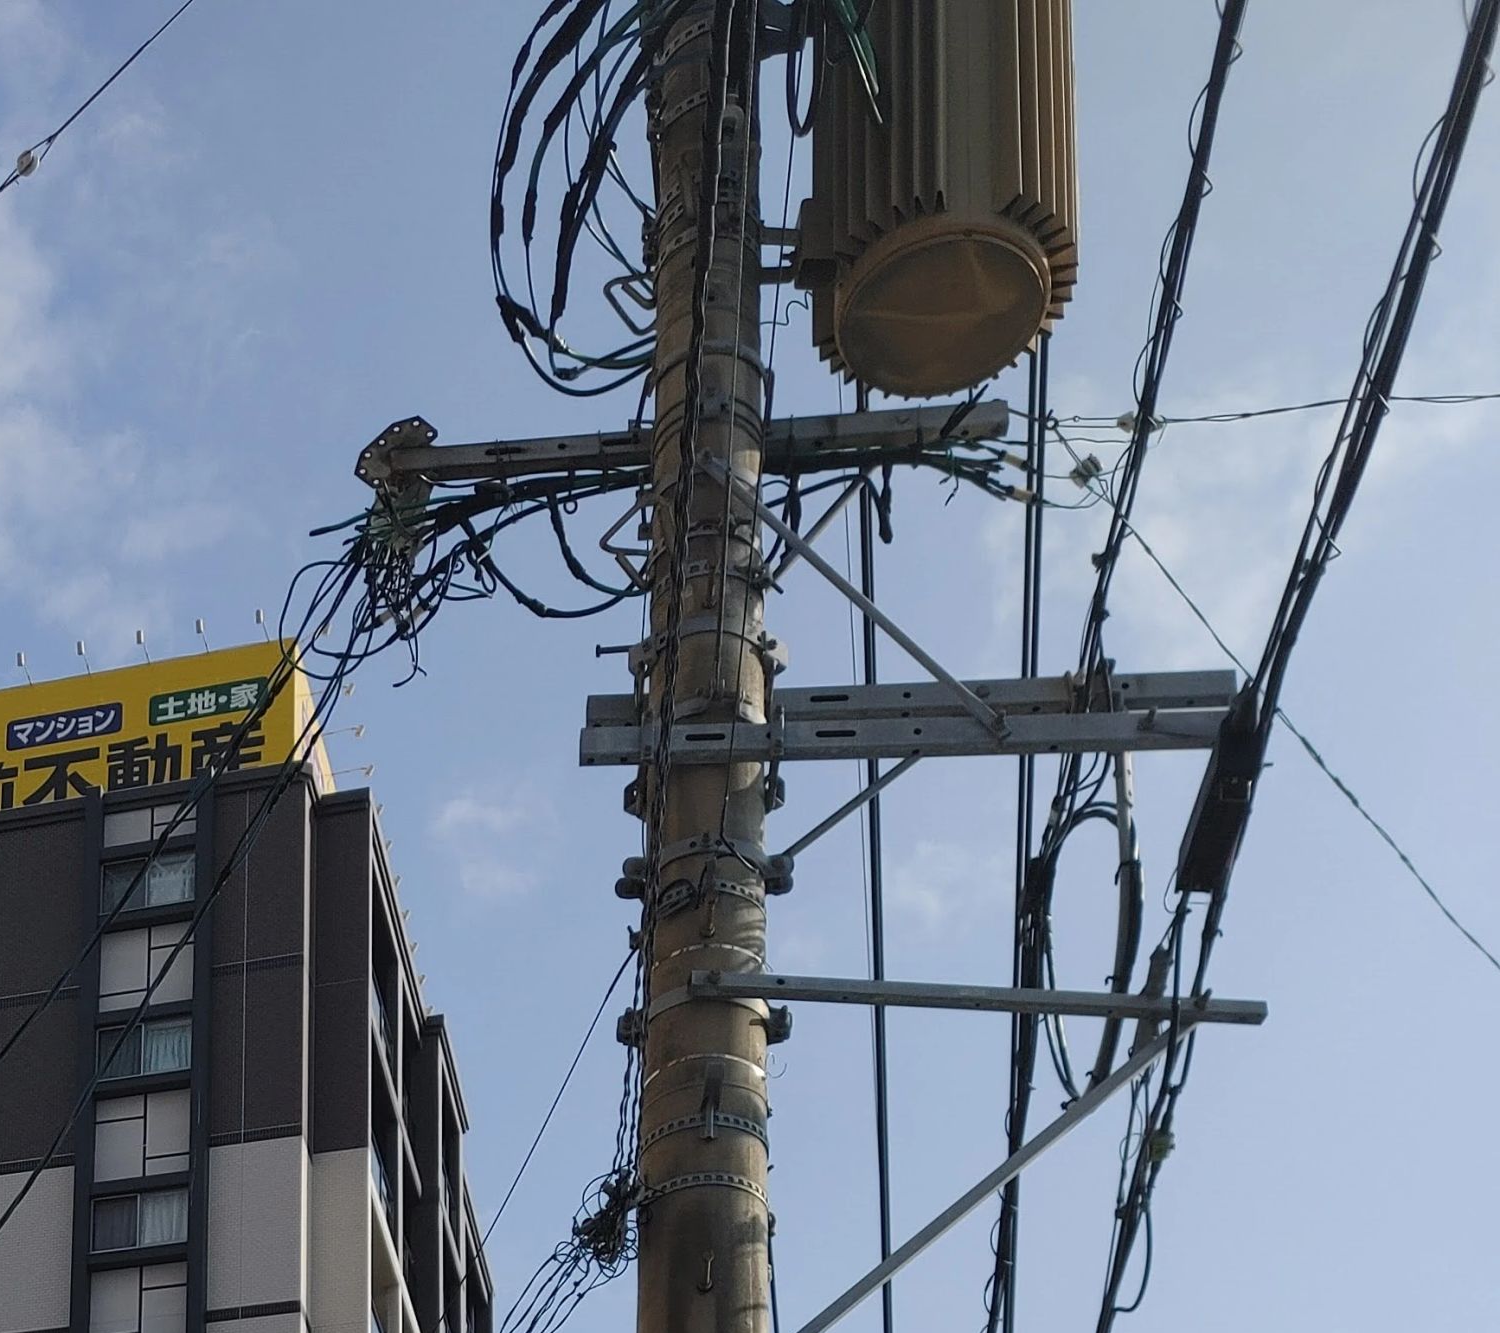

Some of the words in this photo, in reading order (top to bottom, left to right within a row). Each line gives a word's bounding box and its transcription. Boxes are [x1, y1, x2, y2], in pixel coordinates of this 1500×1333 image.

[12, 708, 116, 745] マンション
[156, 682, 259, 722] 土地・家
